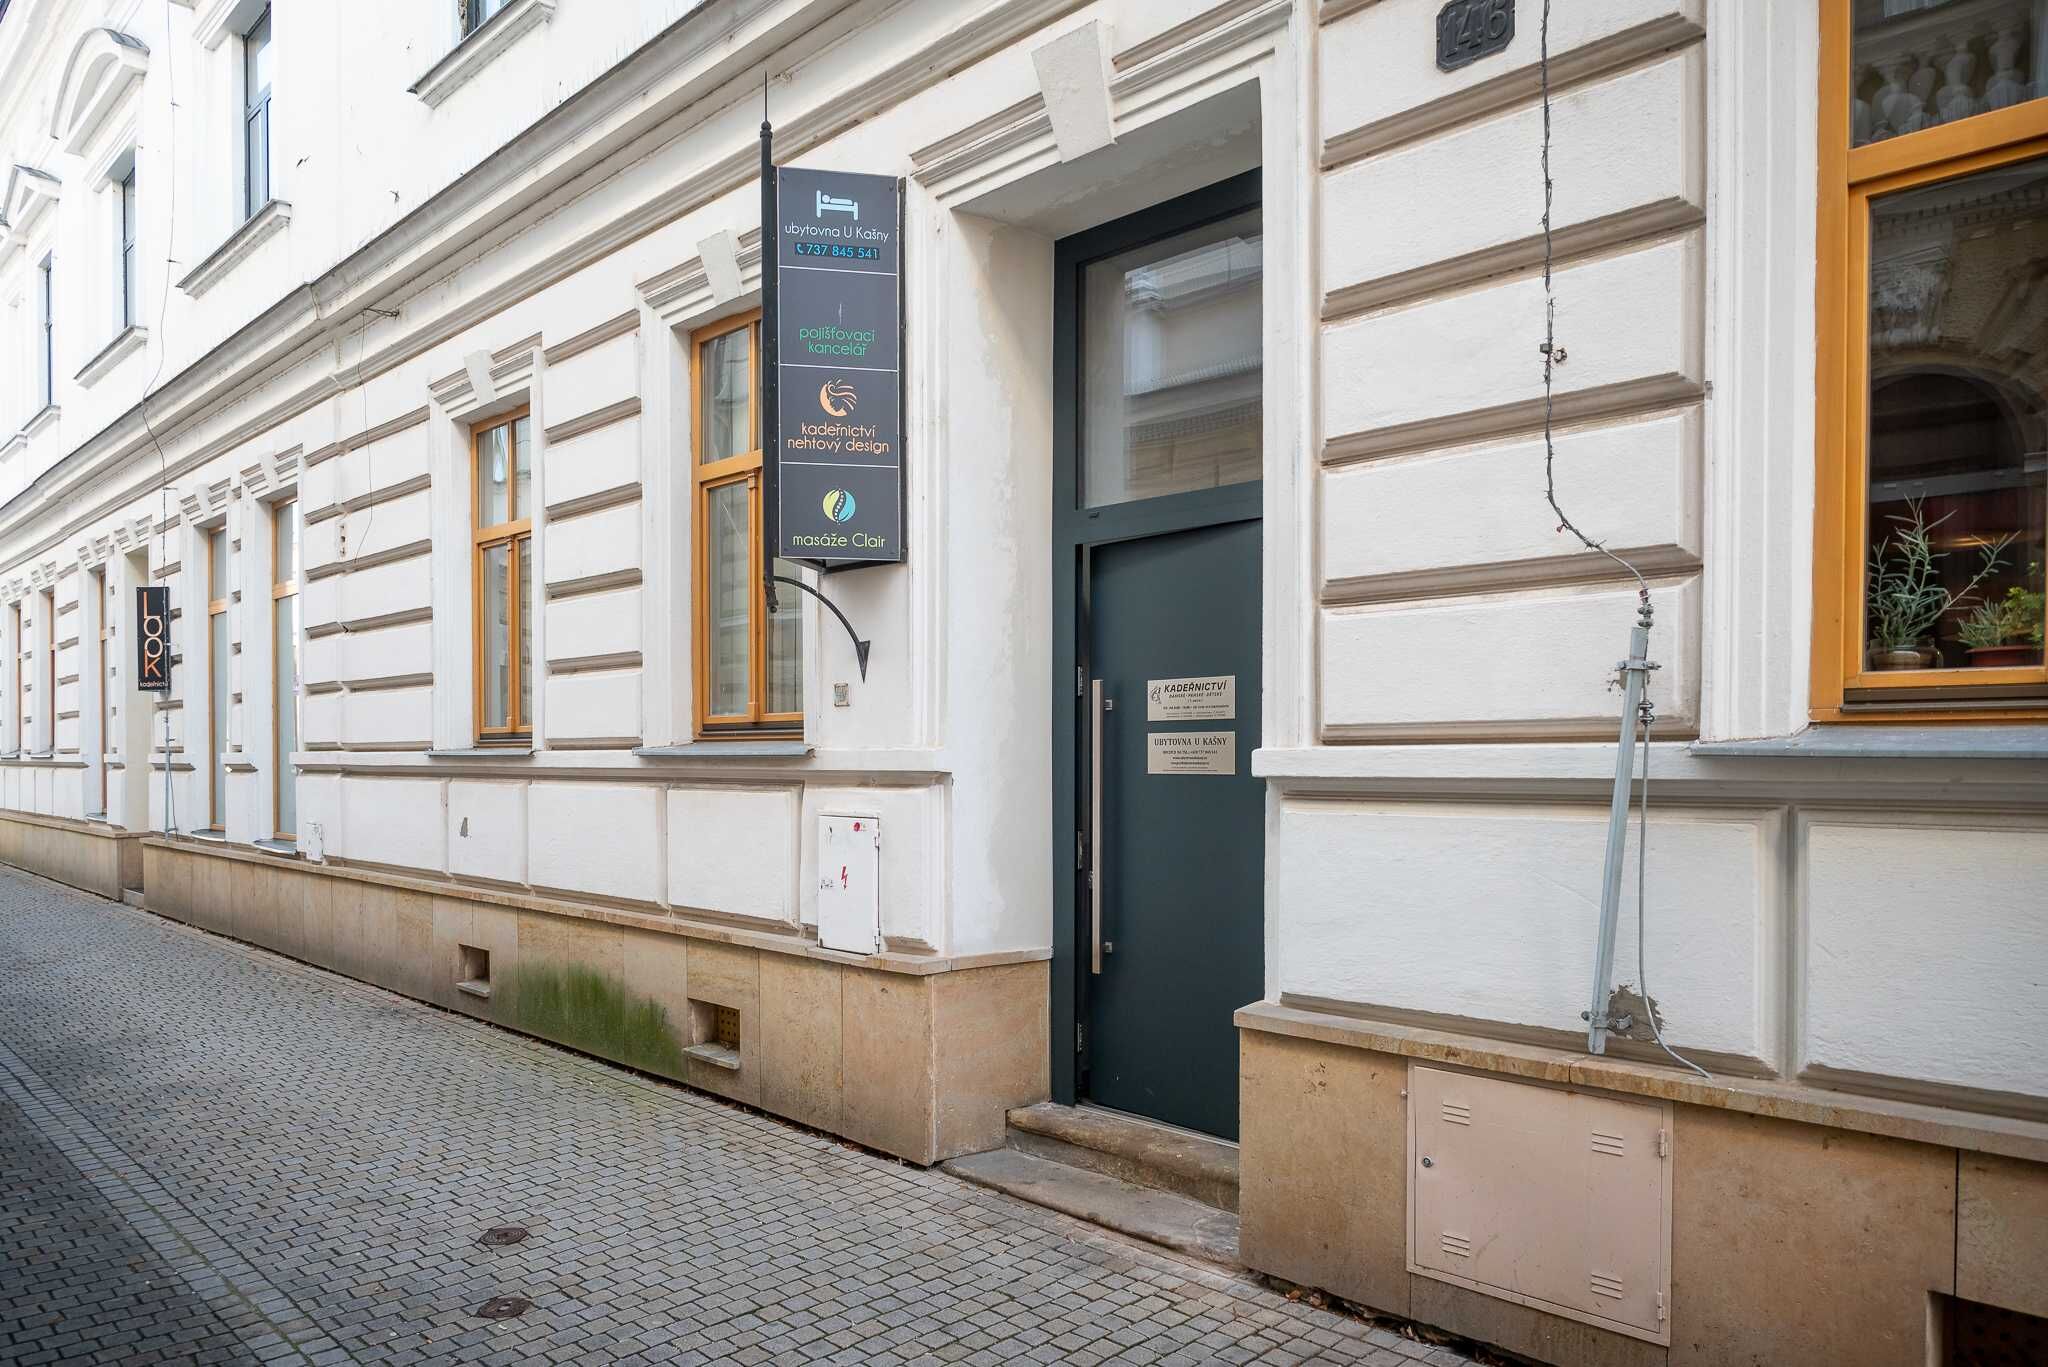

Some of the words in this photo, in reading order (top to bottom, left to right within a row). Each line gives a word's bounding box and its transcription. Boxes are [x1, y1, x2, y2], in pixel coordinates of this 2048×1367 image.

[1444, 0, 1506, 57] 146
[784, 221, 840, 237] ubytovna
[843, 226, 853, 238] U
[856, 226, 889, 243] Kašny
[807, 244, 828, 256] 737
[832, 245, 854, 257] 845
[858, 247, 878, 259] 541
[808, 341, 867, 357] kancelář
[801, 421, 876, 438] kadeřnictví
[787, 436, 841, 454] nehtový
[845, 437, 889, 455] design
[792, 533, 848, 547] masáže
[852, 532, 886, 548] Clair
[143, 591, 163, 678] LOOK
[1163, 680, 1228, 693] KADEŘNICTVÍ
[1154, 737, 1192, 746] UBYTOVNA
[1194, 737, 1200, 746] U
[1203, 735, 1227, 746] KAŠNY
